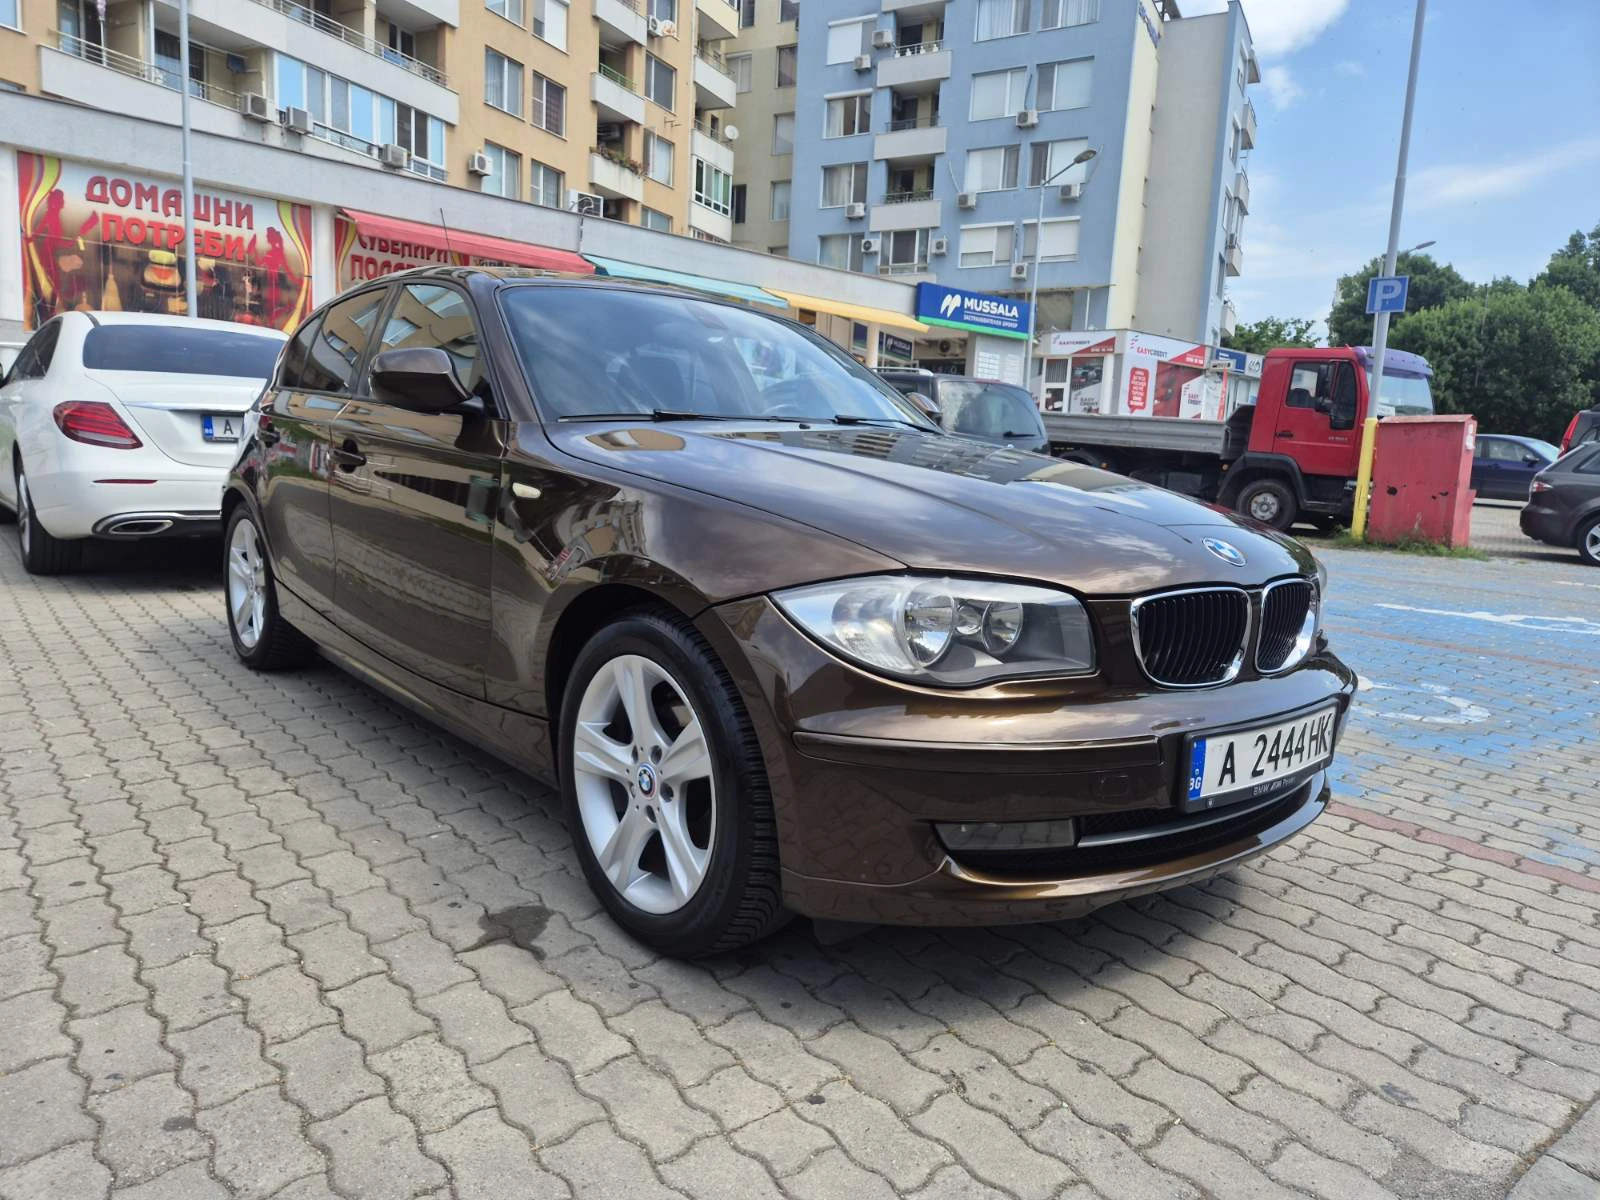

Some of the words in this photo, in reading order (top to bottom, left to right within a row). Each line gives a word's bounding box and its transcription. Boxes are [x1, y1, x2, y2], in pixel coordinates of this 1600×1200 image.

[85, 176, 253, 229] ДОМАШНИ
[102, 213, 245, 262] ПОТРЕБИ
[964, 296, 1019, 318] MUSSALA
[1374, 279, 1402, 311] P
[224, 419, 234, 435] A
[1218, 741, 1236, 787] A
